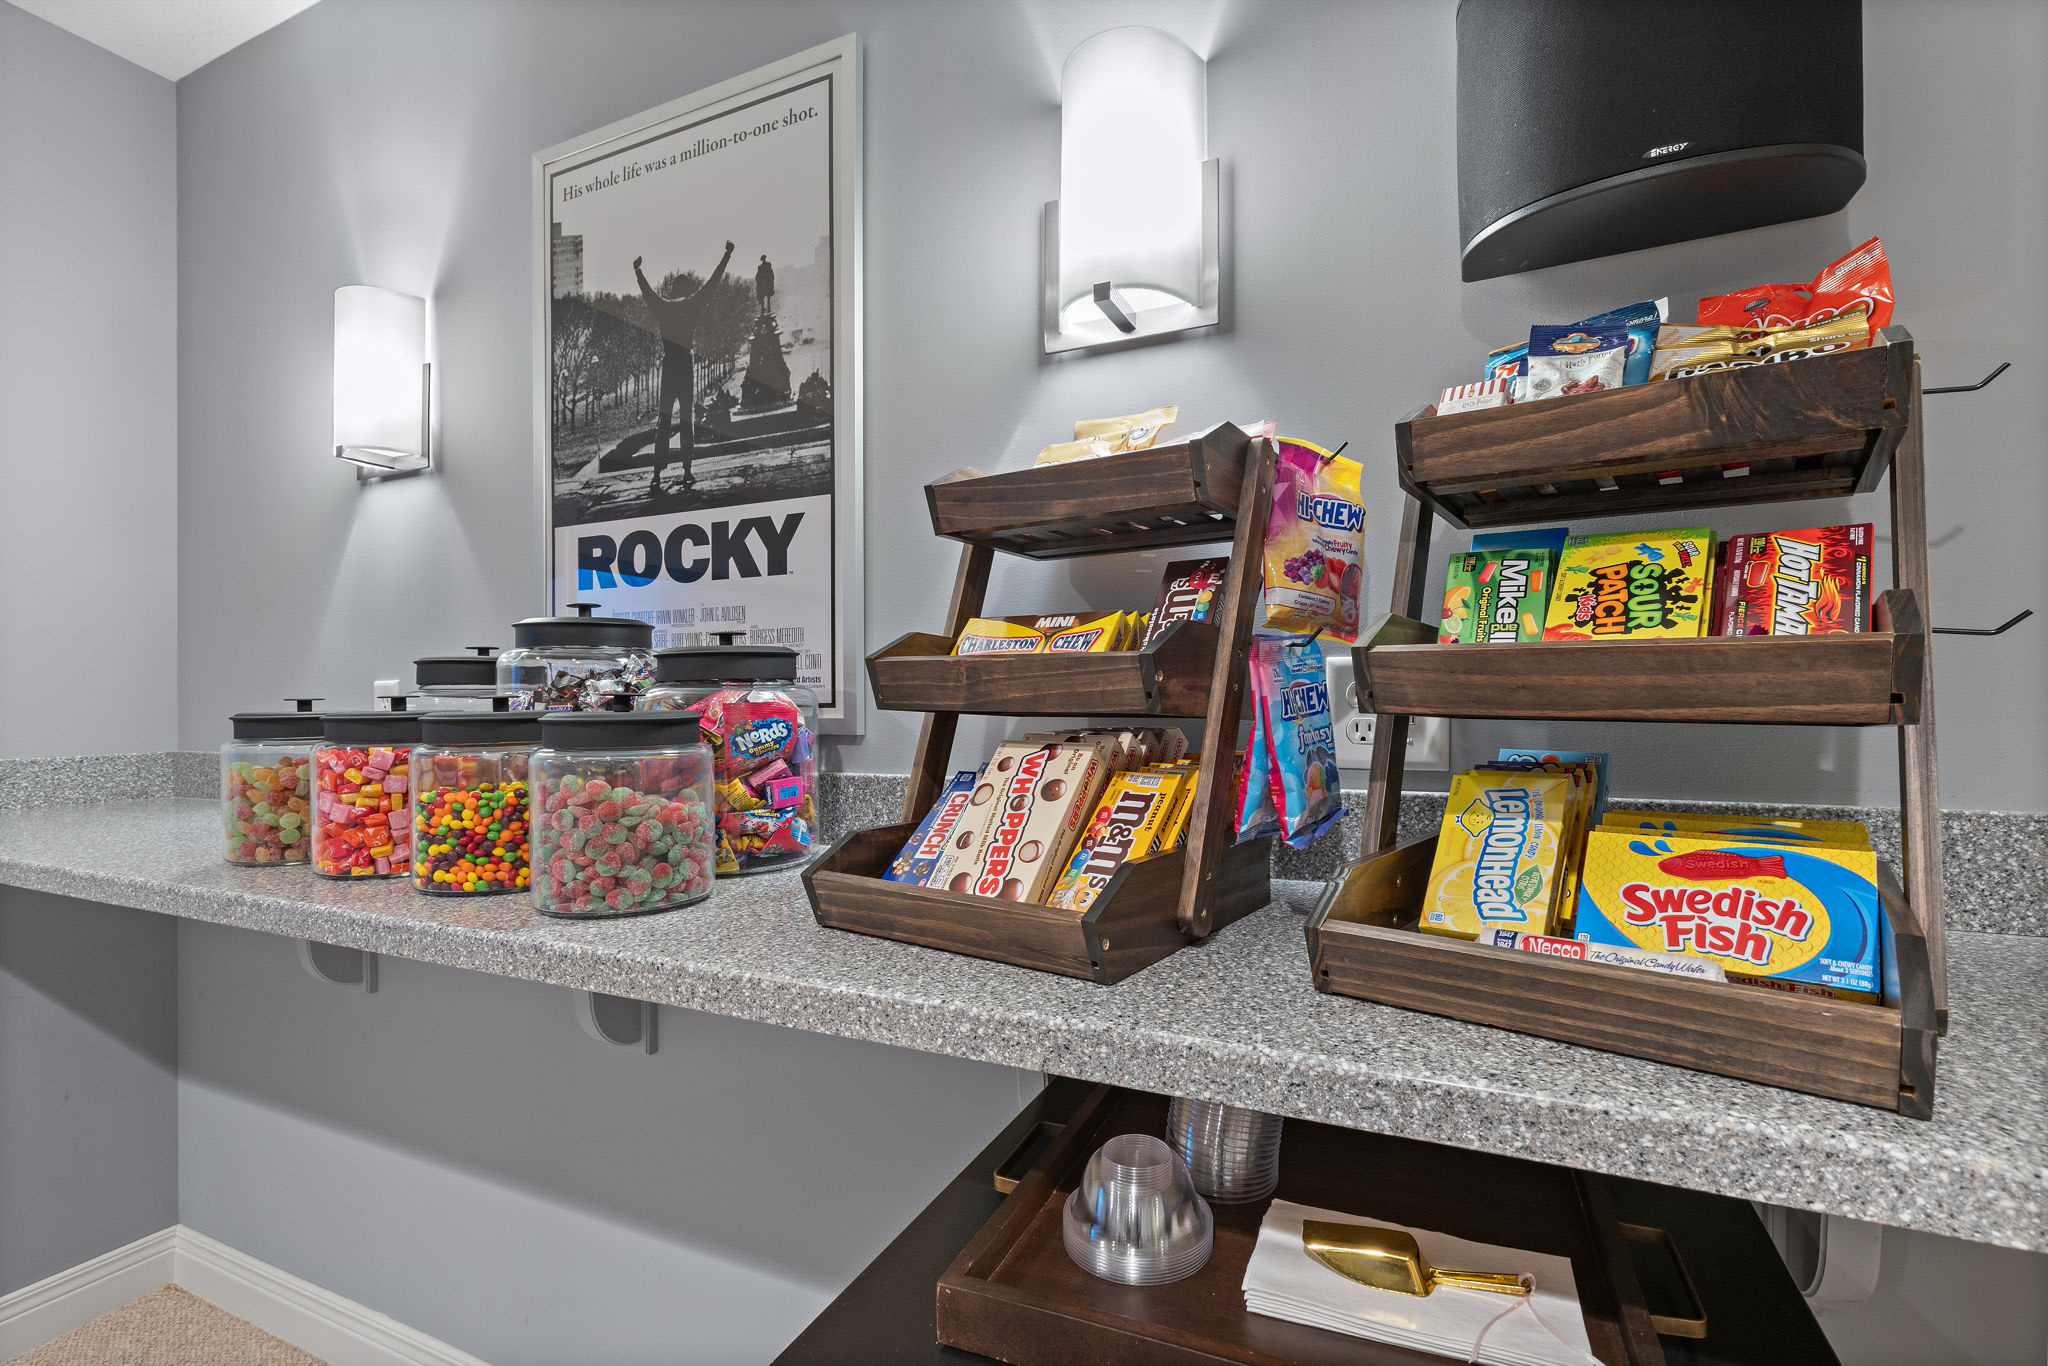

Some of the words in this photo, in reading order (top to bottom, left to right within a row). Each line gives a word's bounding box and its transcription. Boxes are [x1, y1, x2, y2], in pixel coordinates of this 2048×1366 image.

[563, 185, 583, 202] His
[585, 171, 620, 195] whole
[623, 161, 643, 182] life
[645, 158, 668, 175] was
[669, 155, 677, 166] a
[680, 117, 780, 162] million-to-one
[782, 104, 819, 127] shot.
[1650, 142, 1689, 157] ENERGY
[1297, 490, 1366, 533] HI-CHEW
[578, 512, 806, 591] ROCKY
[1333, 539, 1353, 549] Fruity
[1478, 586, 1492, 619] Original
[1496, 559, 1530, 624] Mike
[1592, 563, 1629, 635] PATCH
[1627, 563, 1663, 629] SOUR
[700, 605, 714, 622] JOHN
[721, 604, 746, 621] AVILDSEN
[1577, 593, 1596, 622] Kids
[1738, 601, 1747, 629] FIERCE
[1774, 578, 1819, 636] TAMA
[1034, 615, 1077, 629] MINI
[1475, 620, 1488, 643] Fruits
[684, 631, 703, 647] YOUNG
[749, 627, 776, 645] BURGESS
[776, 626, 805, 644] MEREDITH
[959, 637, 1039, 655] CHARLESTON
[1052, 629, 1100, 652] CHEW
[804, 653, 822, 670] CONTI
[801, 675, 822, 684] Artists
[1063, 748, 1079, 775] Original
[919, 793, 970, 855] CRUNCH
[977, 751, 1047, 896] WHOPPERS
[1144, 792, 1167, 833] peanut
[1685, 858, 1751, 870] Swedish
[1621, 883, 1810, 937] Swedish
[1529, 937, 1582, 960] Necco
[1659, 914, 1768, 961] Fish
[1589, 950, 1605, 961] The
[1604, 952, 1645, 967] Original
[1644, 957, 1677, 974] Candy
[1675, 960, 1707, 975] Wafer
[1819, 957, 1832, 966] SOFT
[1838, 960, 1856, 969] CHEWY
[1856, 962, 1873, 971] CANDY
[1830, 965, 1843, 973] About
[1840, 976, 1849, 984] 3.1
[1850, 978, 1858, 986] OZ
